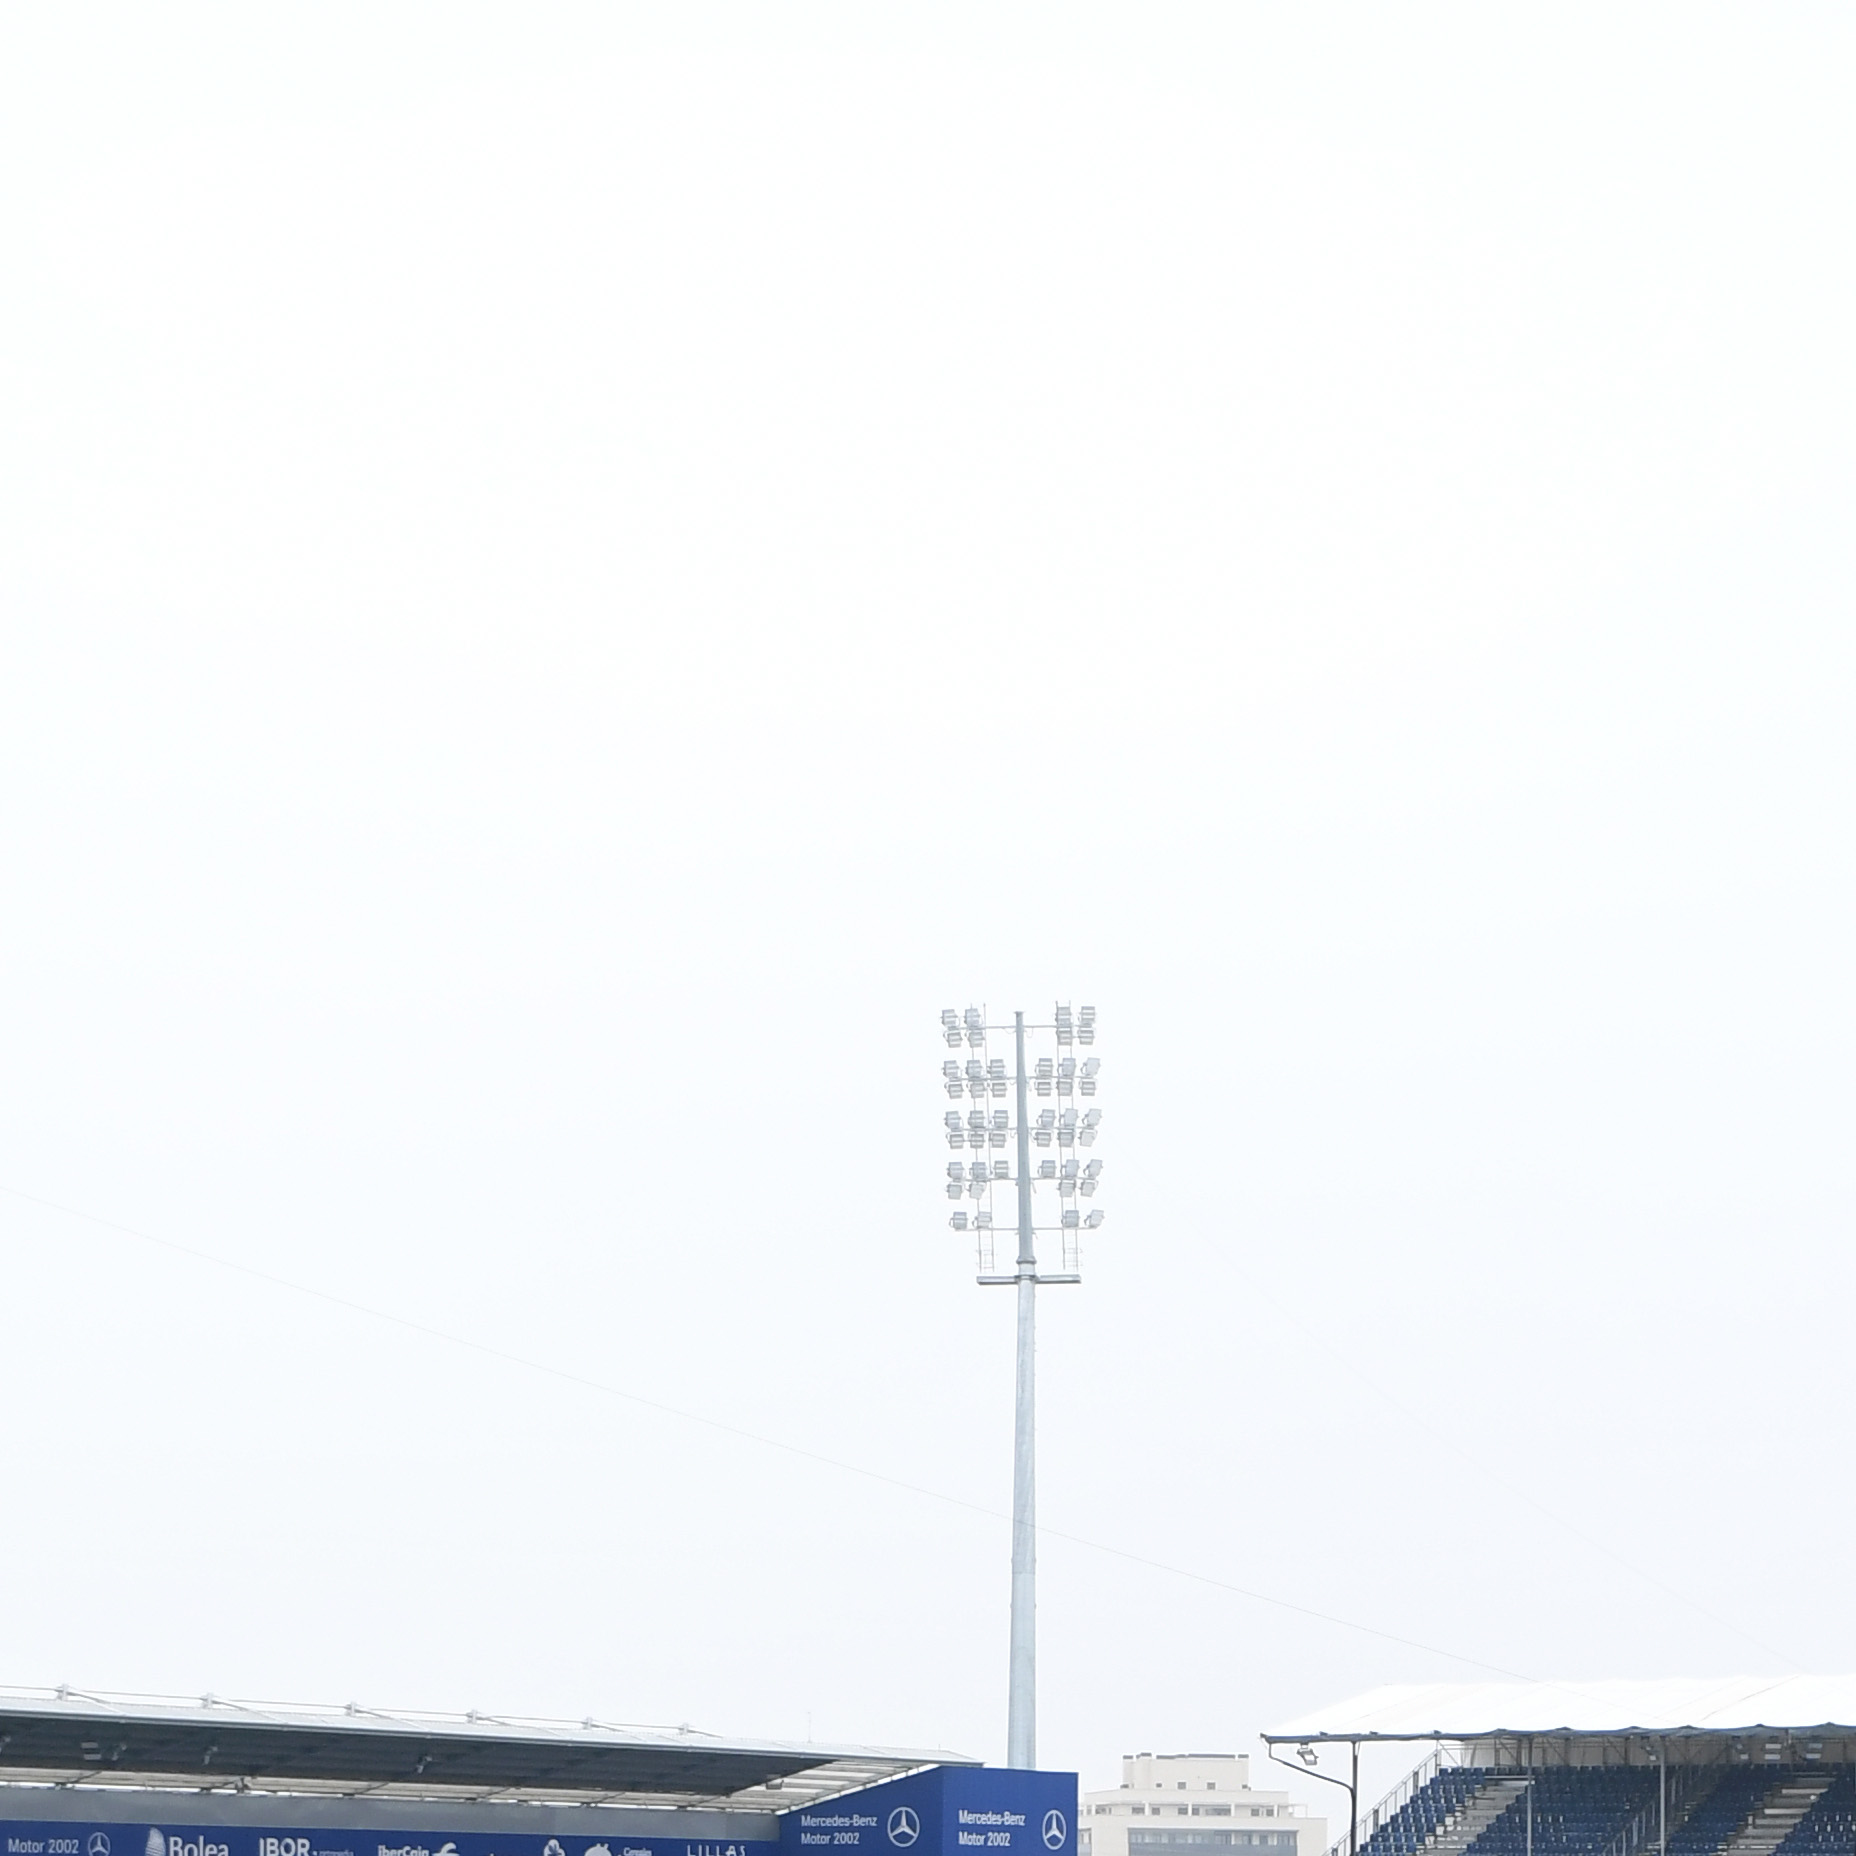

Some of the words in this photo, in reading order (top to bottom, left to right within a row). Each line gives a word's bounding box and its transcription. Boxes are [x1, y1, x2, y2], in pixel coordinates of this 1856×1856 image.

[801, 1813, 878, 1829] Mercedes-Benz
[958, 1810, 1025, 1826] Mercedes-Benz
[8, 1838, 45, 1854] Motor
[48, 1838, 79, 1854] 2002
[801, 1831, 831, 1845] Motor
[834, 1831, 860, 1845] 2002
[958, 1830, 985, 1845] Motor
[988, 1832, 1011, 1847] 2002
